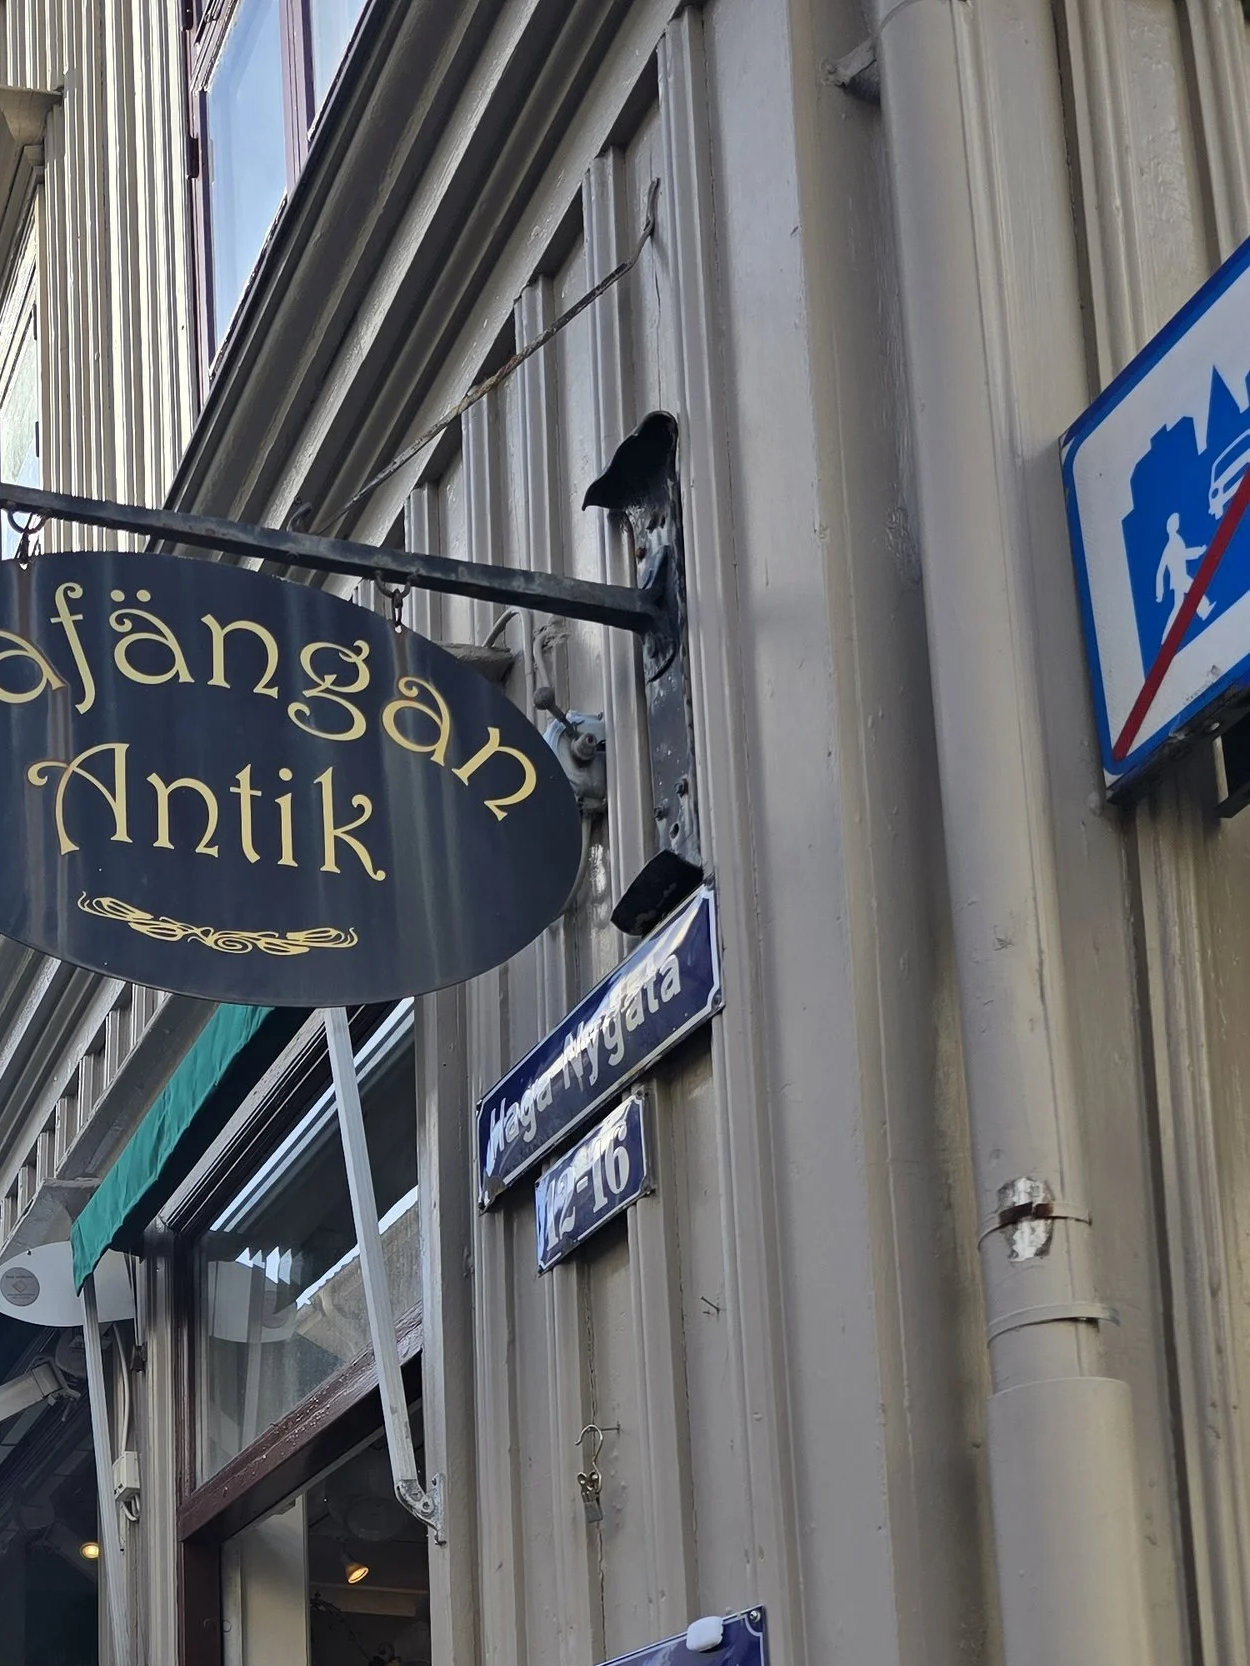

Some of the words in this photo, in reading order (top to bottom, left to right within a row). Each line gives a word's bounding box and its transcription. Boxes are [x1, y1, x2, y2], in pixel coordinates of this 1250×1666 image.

[27, 741, 387, 882] Antik
[486, 1078, 553, 1172] Haga
[563, 954, 681, 1091] Nygata
